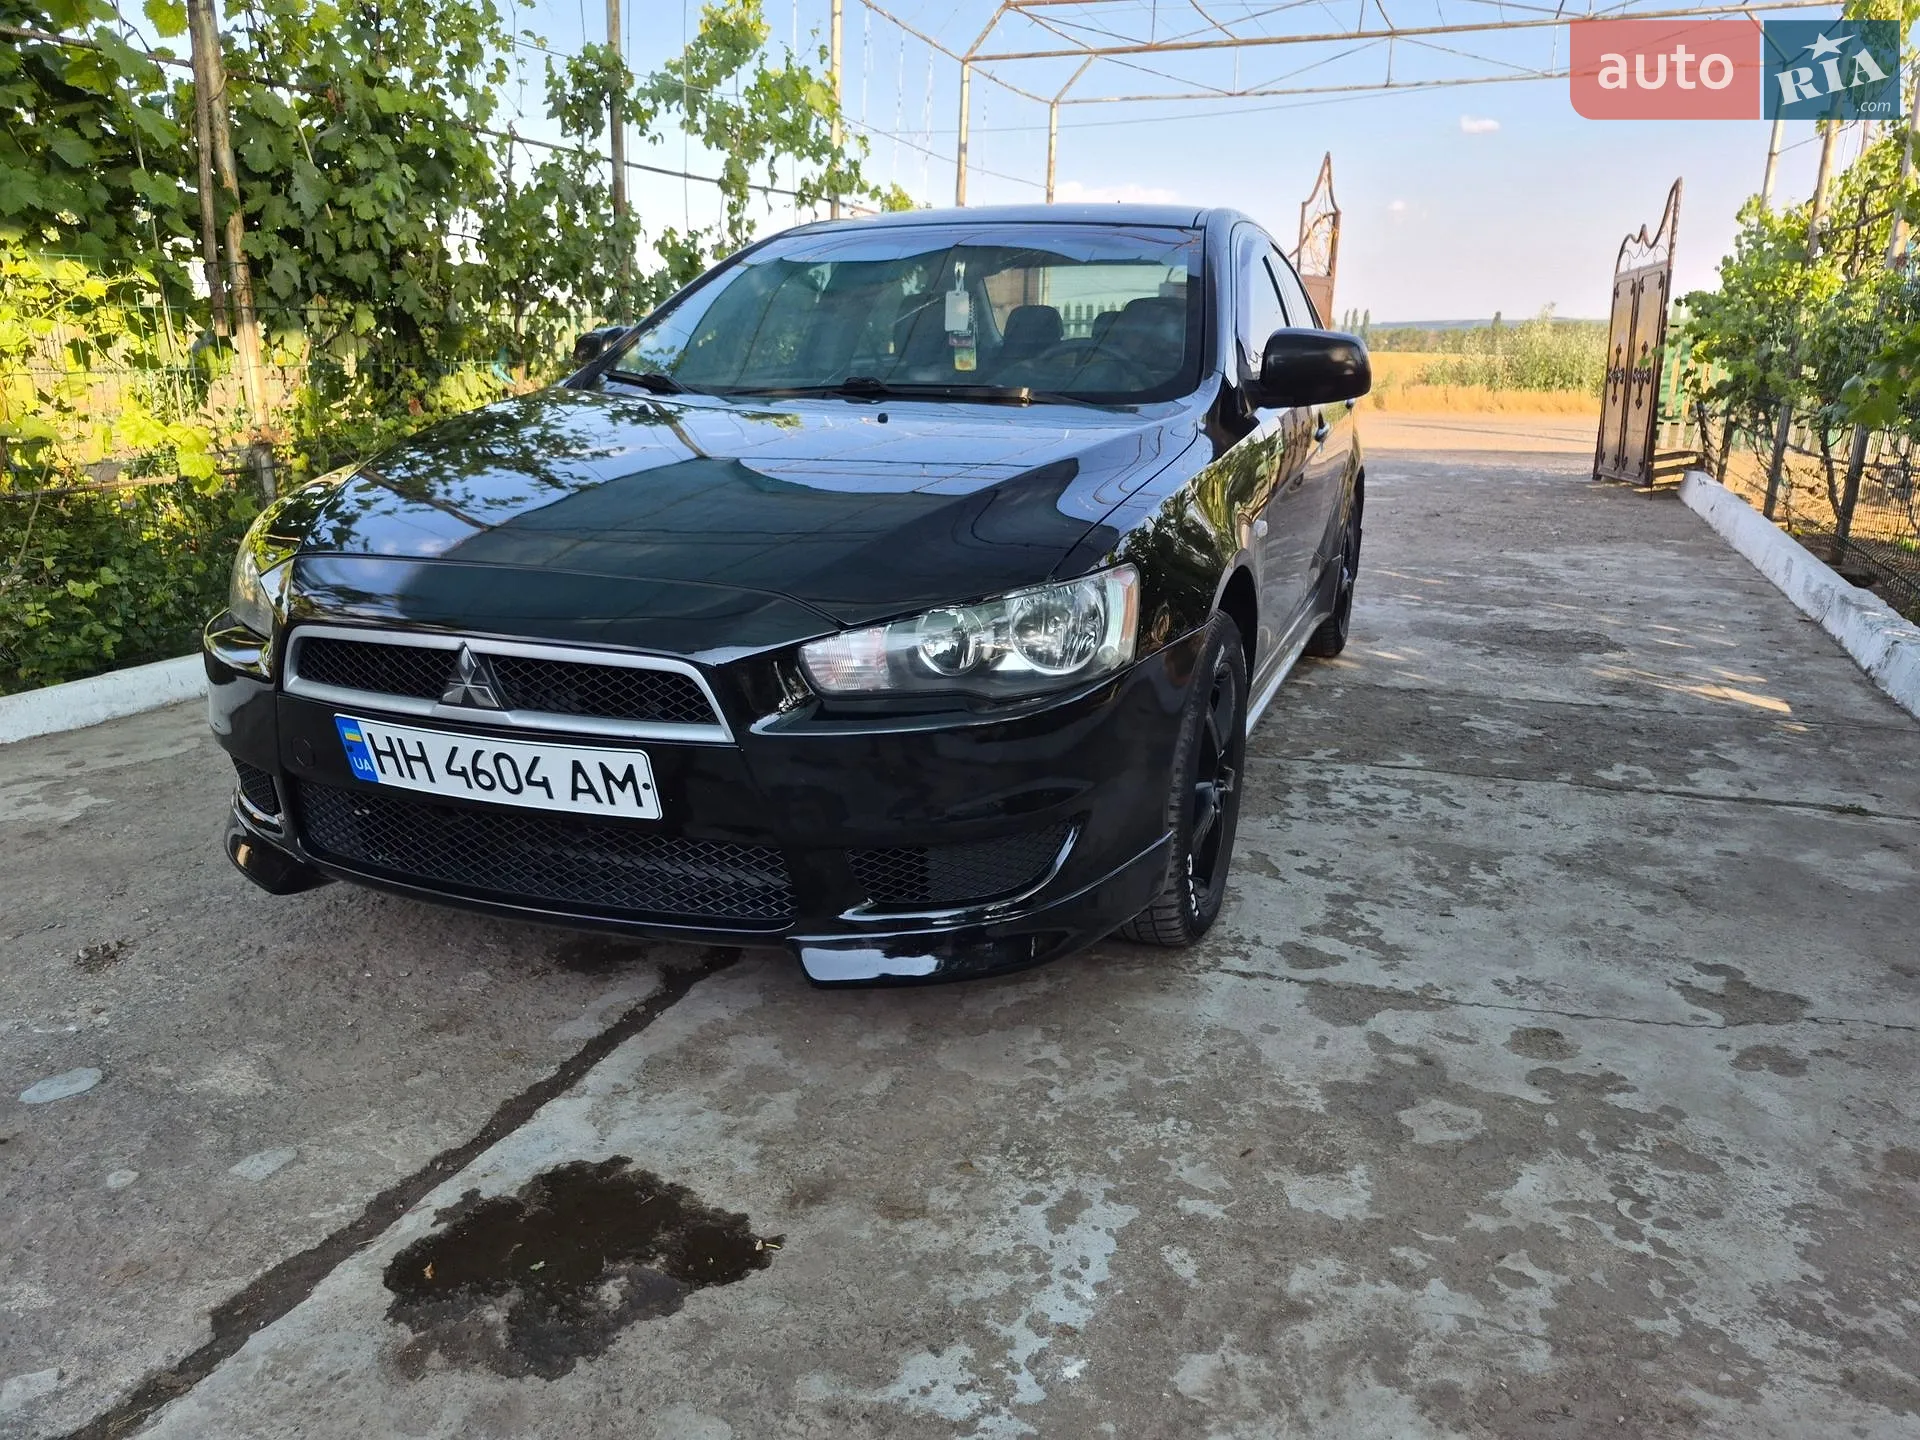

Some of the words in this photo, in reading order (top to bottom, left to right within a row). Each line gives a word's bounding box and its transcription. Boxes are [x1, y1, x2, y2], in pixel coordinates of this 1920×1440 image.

[352, 756, 374, 773] UA
[366, 732, 437, 784] HH
[445, 746, 555, 801] 4604
[570, 759, 645, 808] AM
